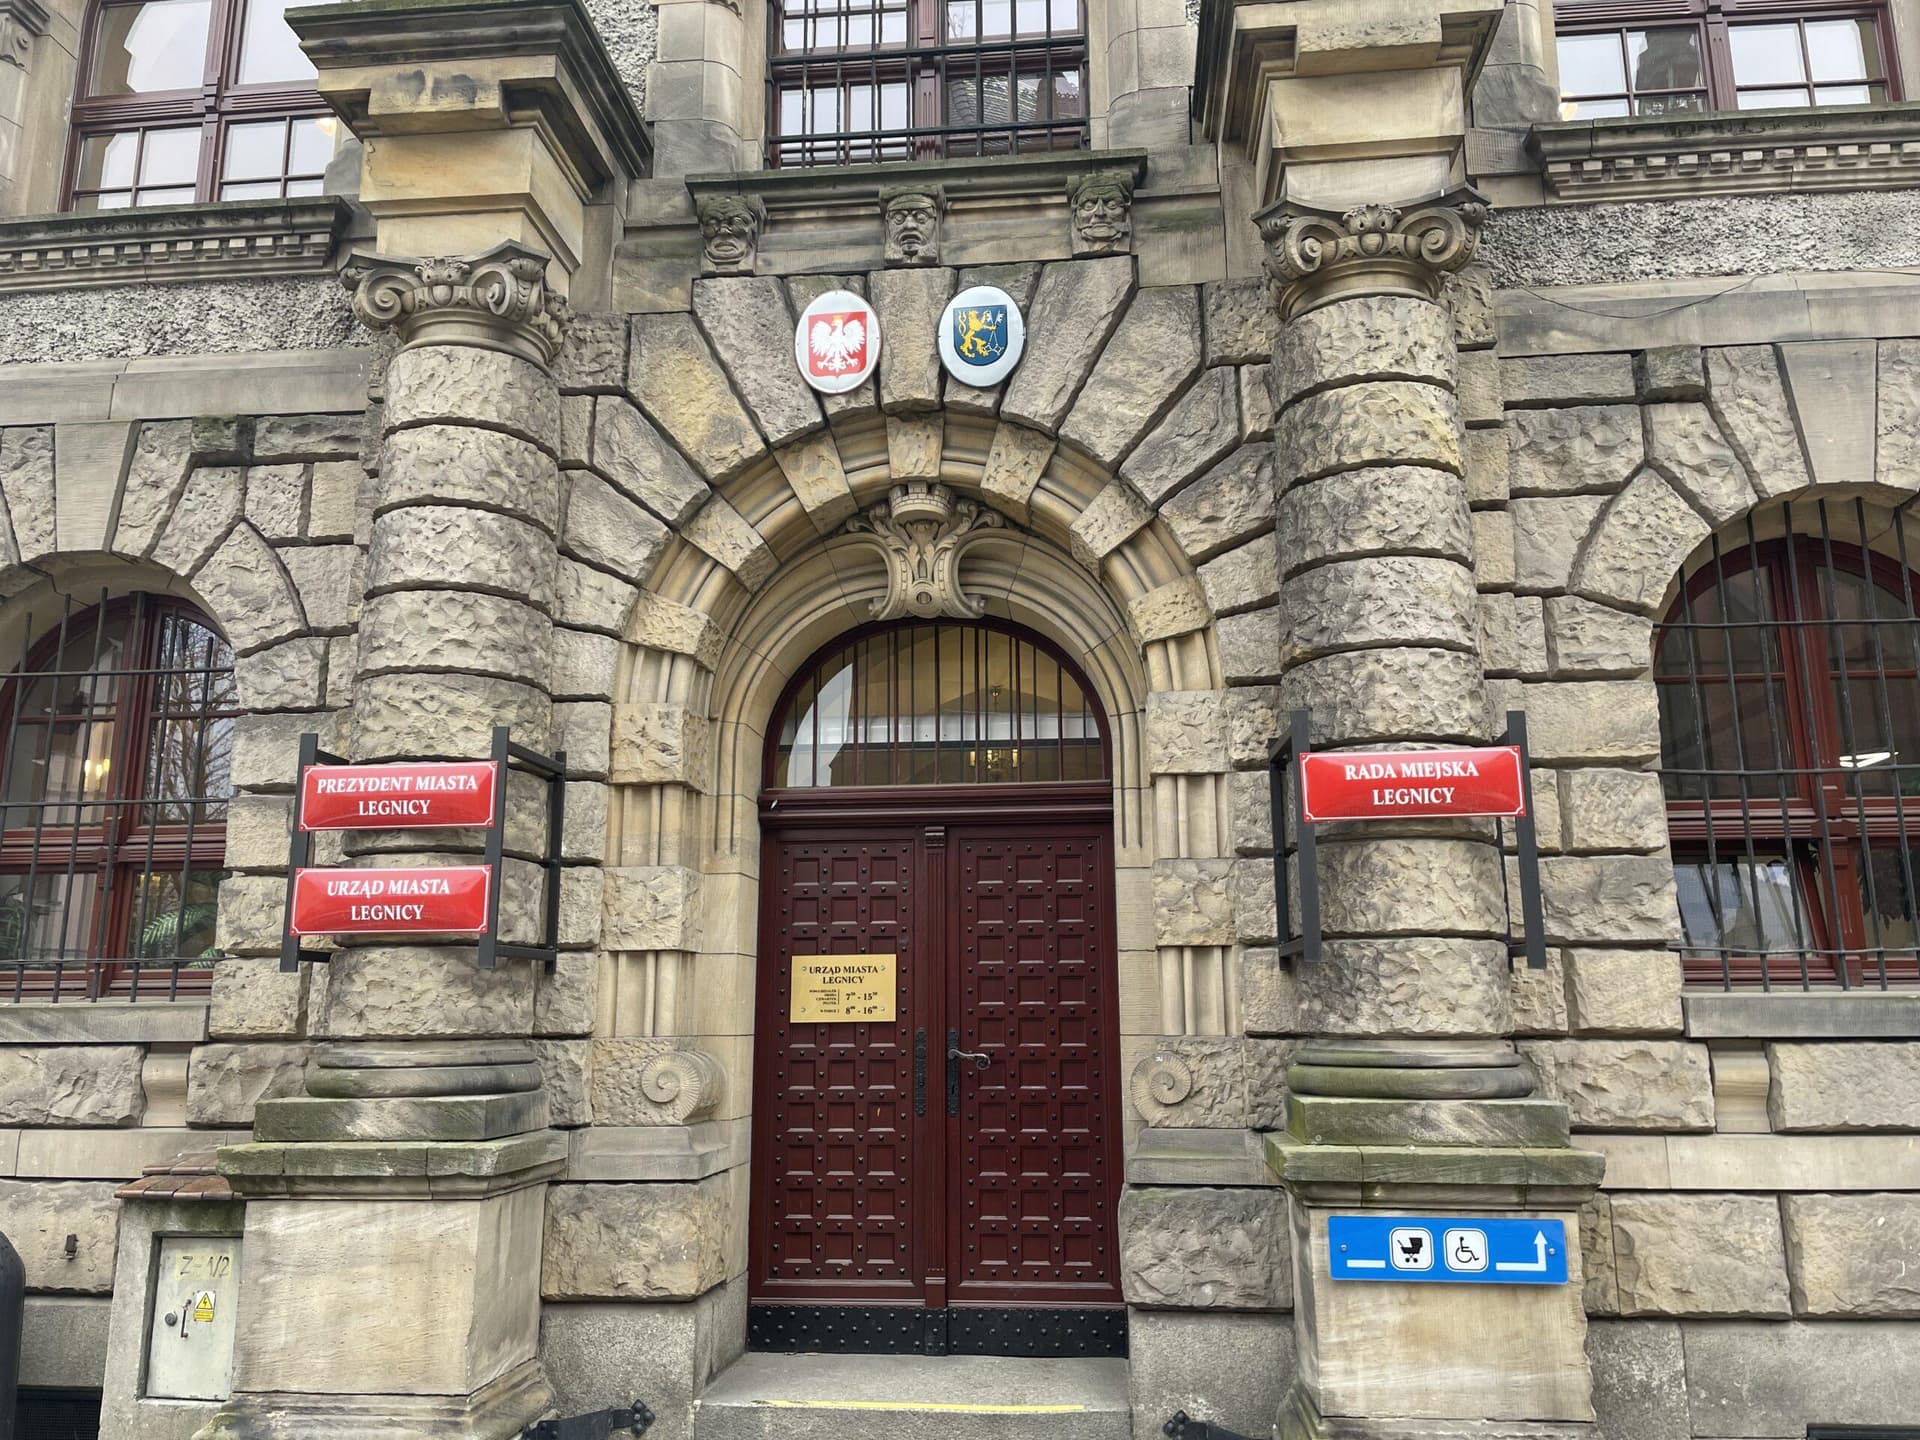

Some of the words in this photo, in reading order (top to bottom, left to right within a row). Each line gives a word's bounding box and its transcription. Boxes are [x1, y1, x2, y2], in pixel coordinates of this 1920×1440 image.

[1345, 763, 1397, 780] RADA
[1401, 760, 1479, 778] MIEJSKA
[317, 776, 412, 793] PREZYDENT
[415, 774, 478, 791] MIASTA
[1372, 787, 1455, 806] LEGNICY
[358, 799, 431, 816] LEGNICY
[327, 880, 384, 899] URZĄD
[387, 879, 450, 895] MIASTA
[351, 904, 424, 921] LEGNICY
[809, 966, 841, 975] URZĄD
[843, 965, 879, 973] MIASTA
[823, 976, 865, 984] LEGNICY
